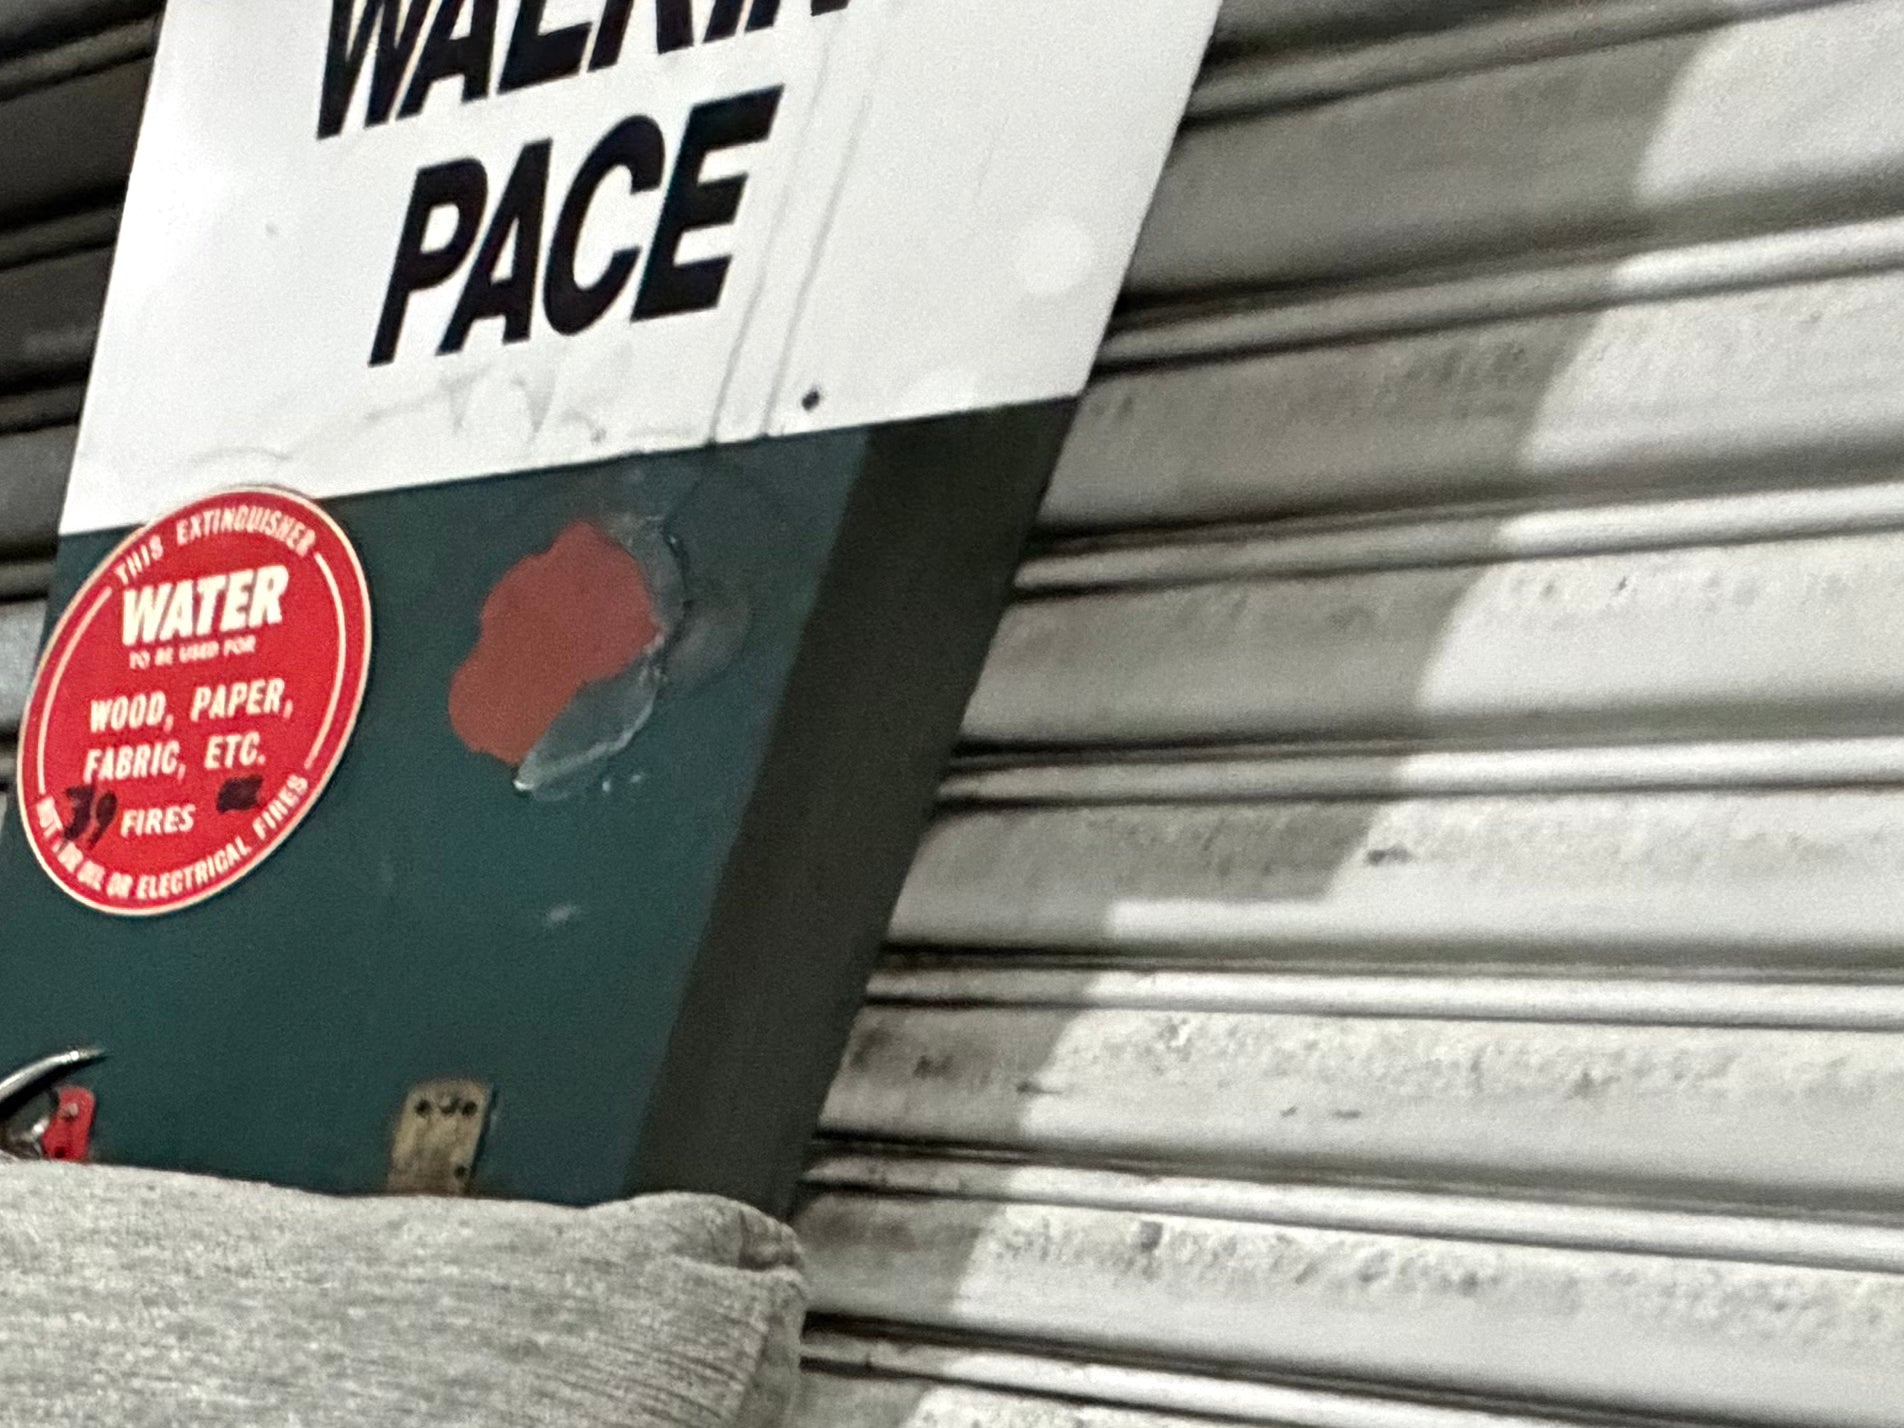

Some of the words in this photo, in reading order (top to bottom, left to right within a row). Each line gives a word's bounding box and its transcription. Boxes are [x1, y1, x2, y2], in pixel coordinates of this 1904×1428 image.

[368, 84, 785, 368] PACE
[114, 535, 164, 585] THIS
[176, 505, 316, 557] EXTINGUISHER
[122, 564, 290, 646] WATER
[129, 650, 151, 669] TO
[154, 647, 174, 666] BE
[223, 635, 256, 657] FOR
[90, 690, 174, 733] WOOD,
[190, 677, 294, 722] PAPER,
[83, 740, 186, 784] FABRIC,
[204, 731, 266, 769] ETC.
[106, 871, 133, 899] OR
[135, 835, 252, 900] ELECTRICAL
[252, 774, 309, 841] FIRES
[120, 804, 197, 837] FIRES
